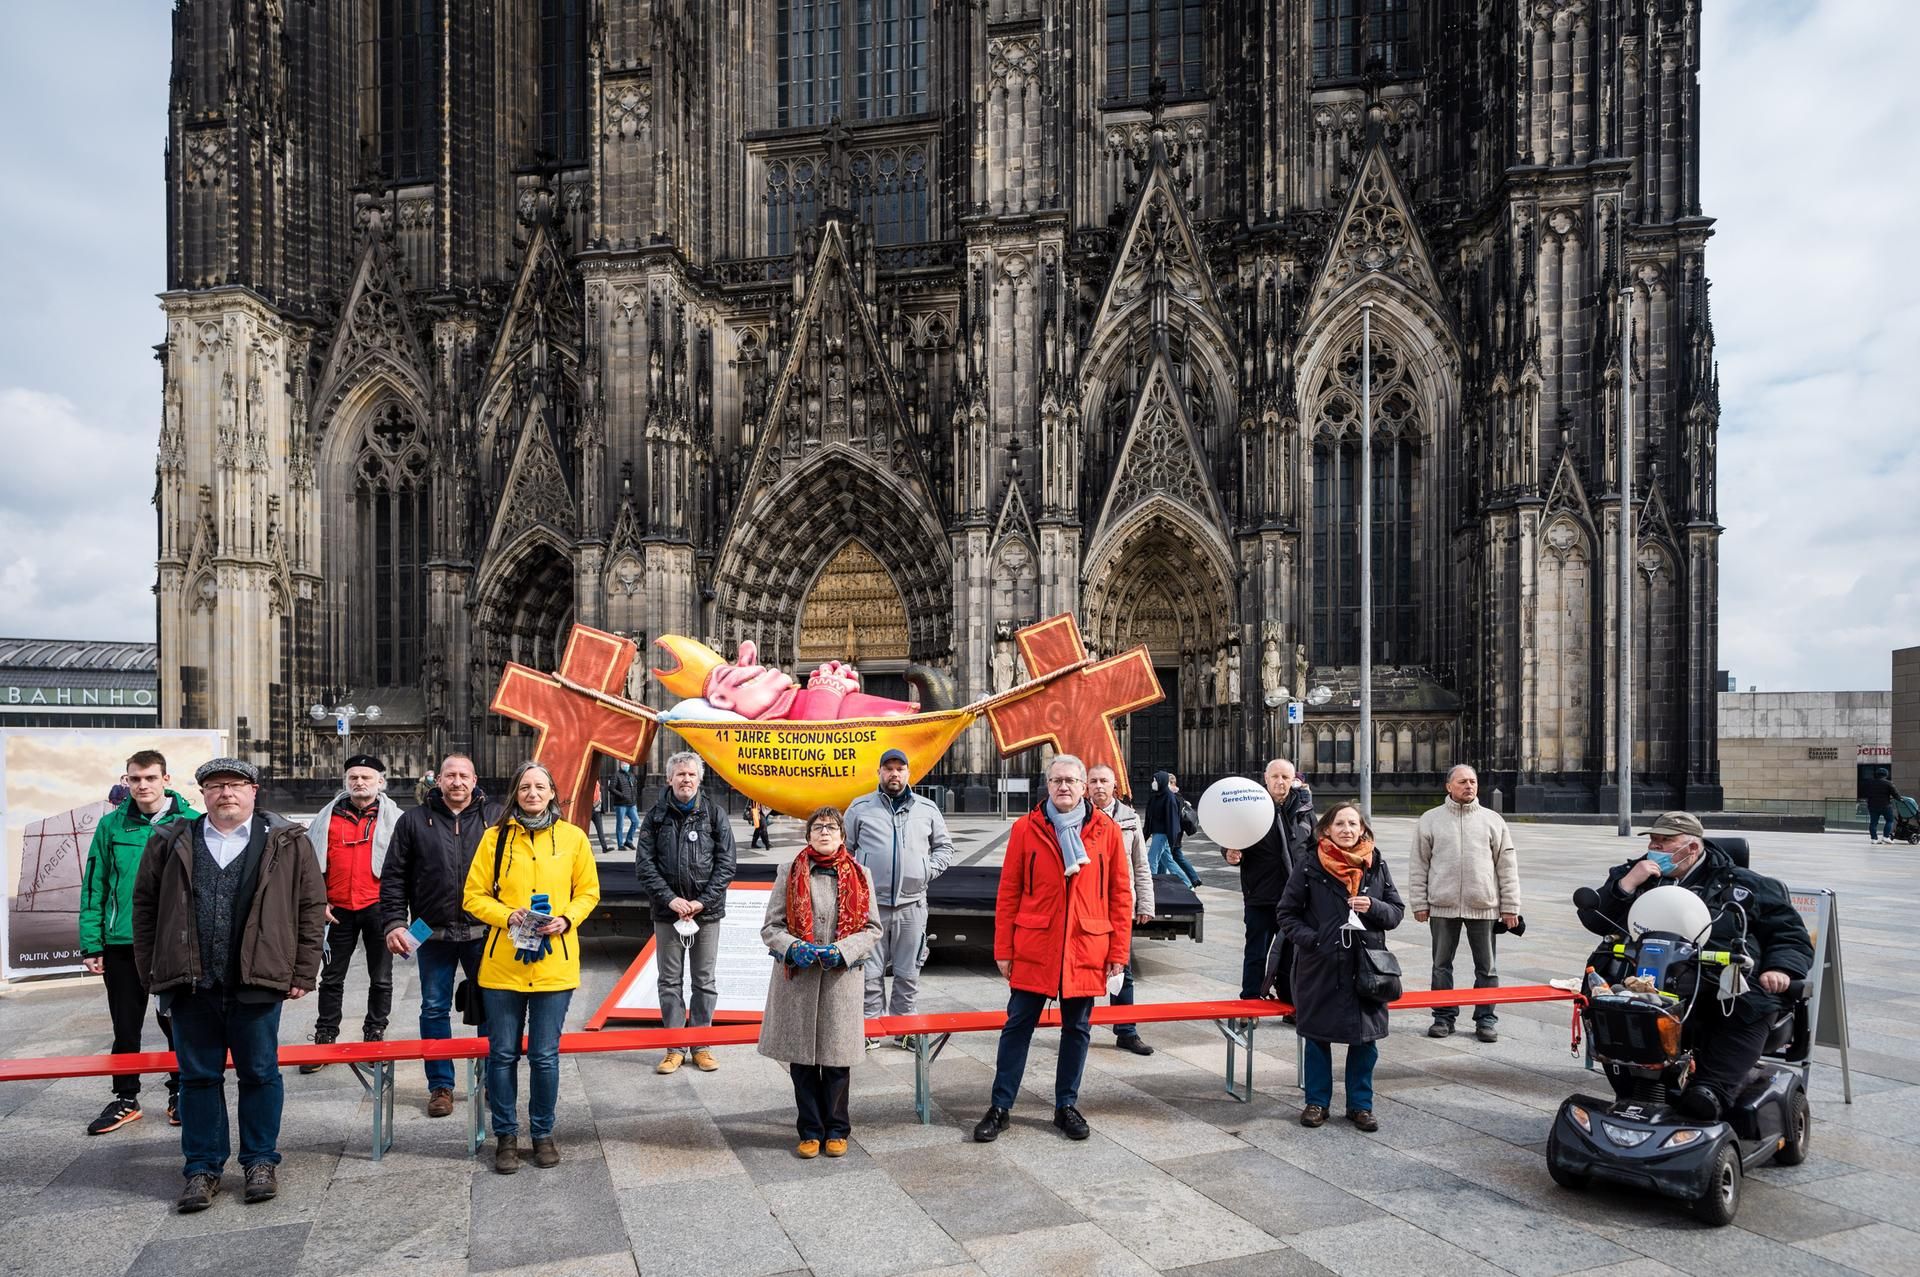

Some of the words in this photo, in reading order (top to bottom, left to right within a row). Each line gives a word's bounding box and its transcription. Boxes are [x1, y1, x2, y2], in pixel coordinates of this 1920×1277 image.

[716, 730, 729, 742] 11
[735, 730, 771, 744] JAHRE
[778, 730, 877, 744] SCHONUNGSLOSE
[737, 747, 826, 761] AUFARBEITUNG
[833, 748, 856, 760] DER
[19, 953, 49, 962] POLITIK
[52, 950, 70, 960] UND
